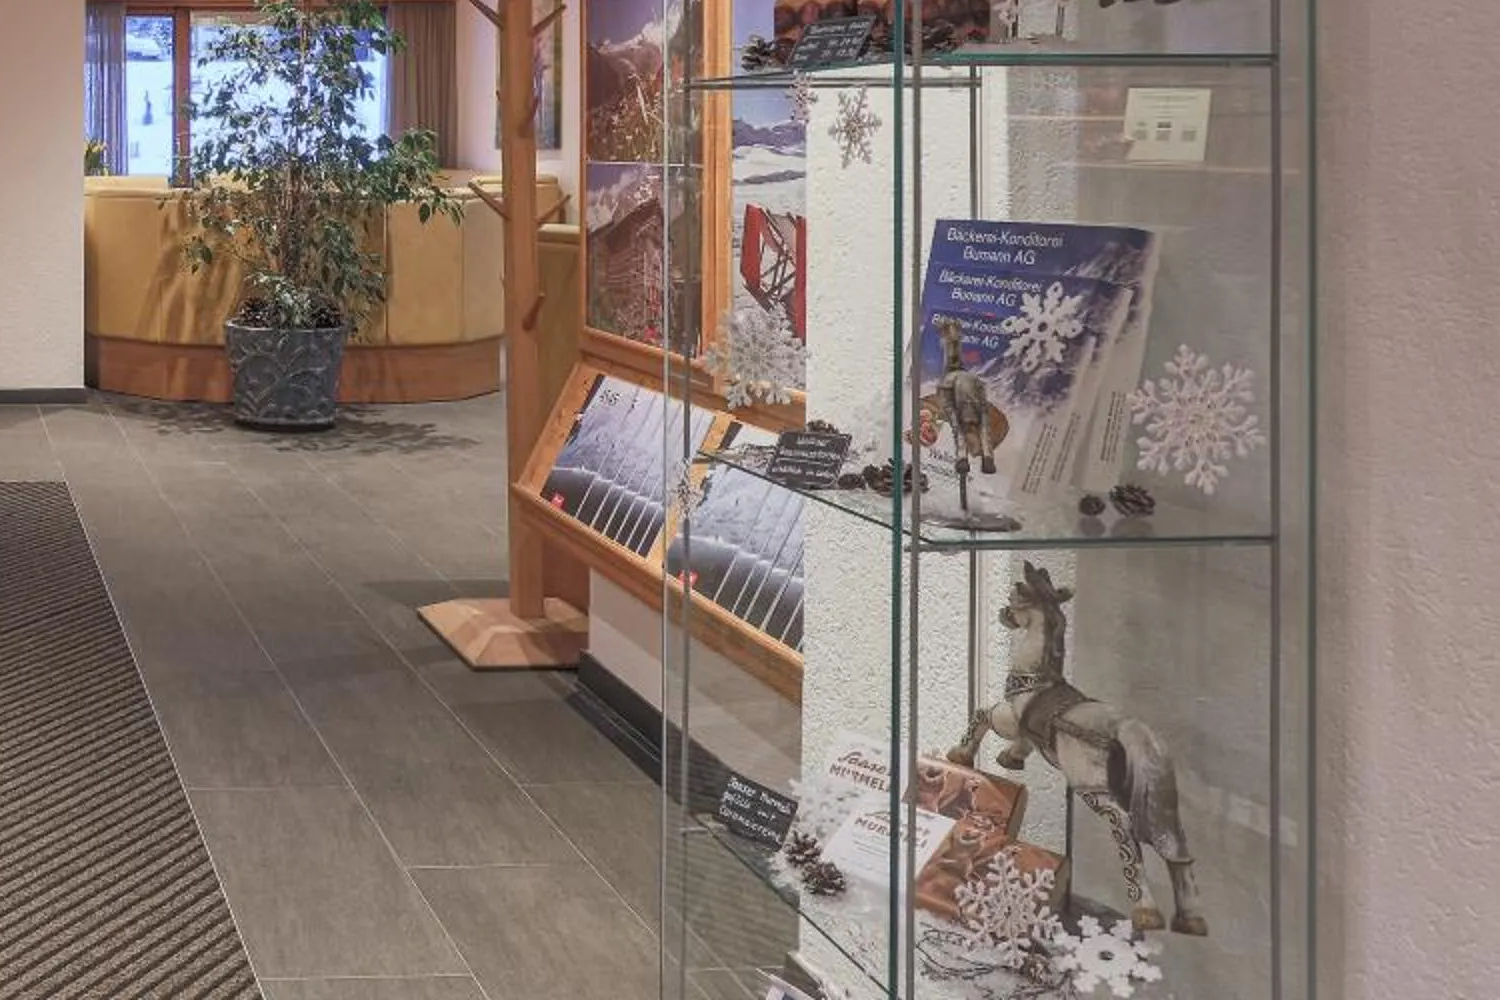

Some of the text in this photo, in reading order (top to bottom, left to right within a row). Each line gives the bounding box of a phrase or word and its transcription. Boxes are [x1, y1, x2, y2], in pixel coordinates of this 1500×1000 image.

[1013, 248, 1037, 265] AG
[996, 292, 1018, 307] AG
[829, 762, 891, 793] MURMEL
